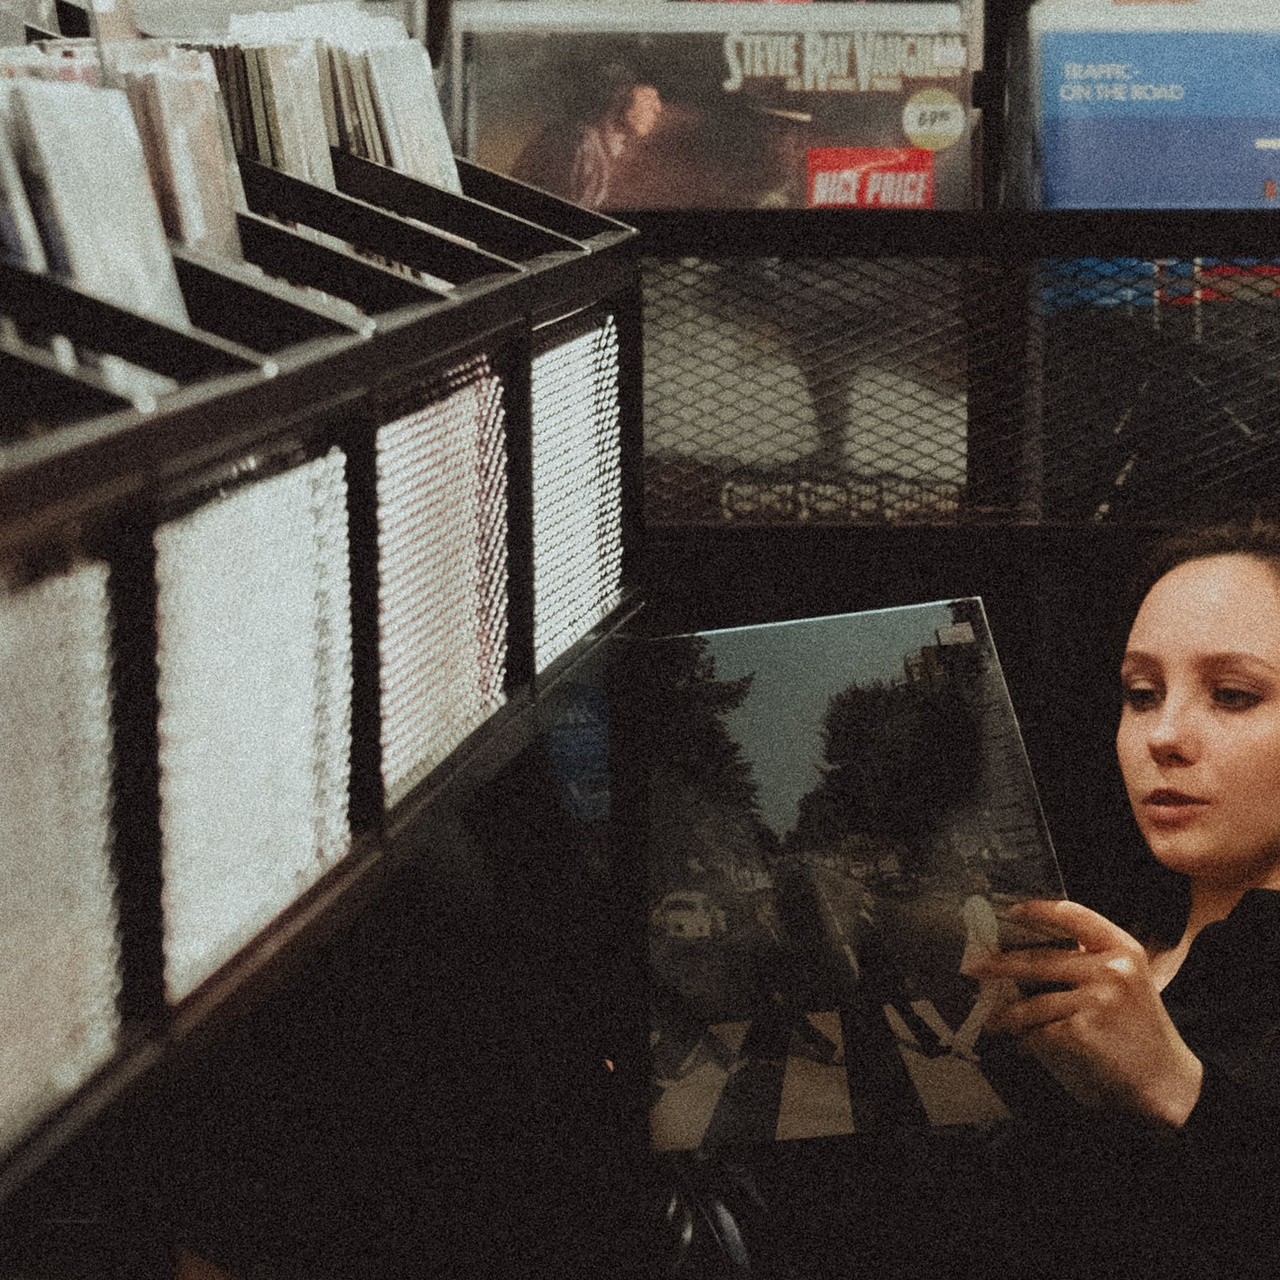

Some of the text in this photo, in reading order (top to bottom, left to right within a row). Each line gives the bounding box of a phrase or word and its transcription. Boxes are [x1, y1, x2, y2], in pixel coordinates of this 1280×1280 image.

[722, 26, 800, 92] STEVIE
[802, 28, 854, 91] RAY
[811, 172, 927, 205] NICE PRICE
